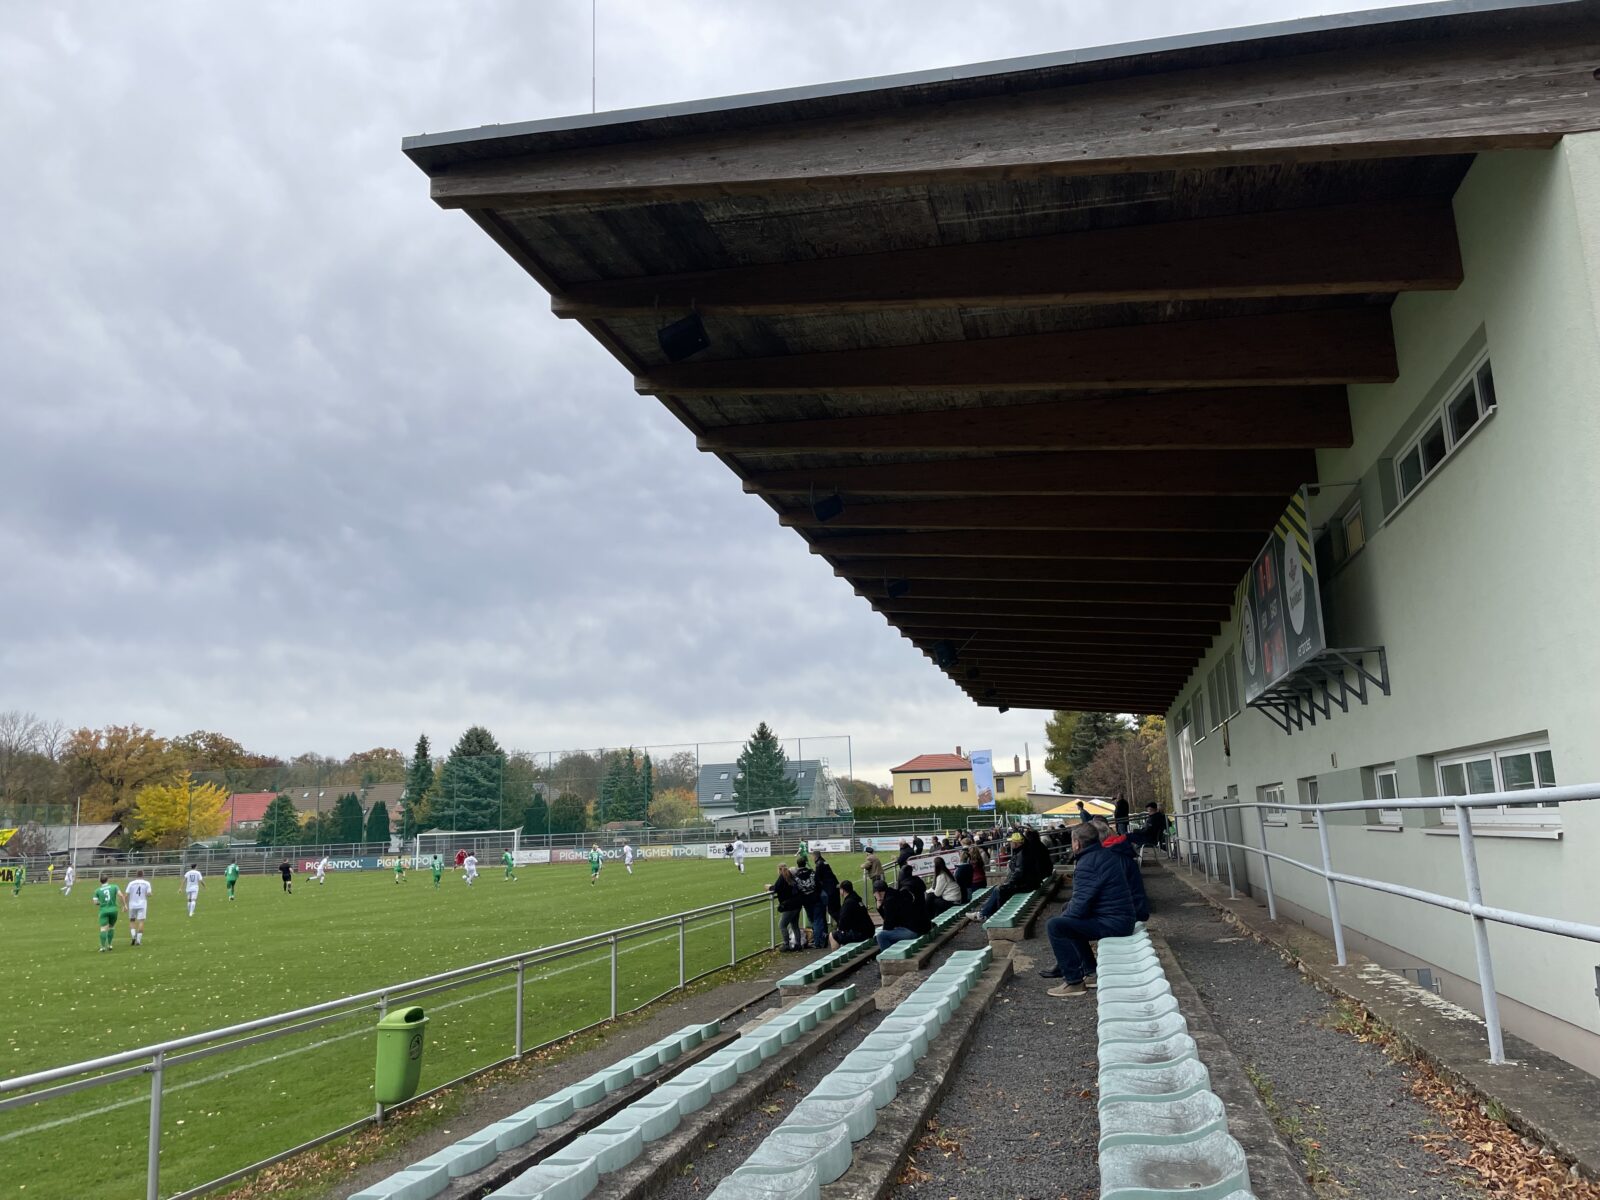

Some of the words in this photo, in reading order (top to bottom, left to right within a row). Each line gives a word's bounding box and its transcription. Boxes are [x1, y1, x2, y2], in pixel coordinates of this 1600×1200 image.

[559, 849, 619, 861] PIGMEPOL
[636, 847, 697, 858] PIGMENTPOL
[305, 859, 362, 871] PIGENTPOL
[103, 889, 111, 902] 3
[135, 885, 141, 896] 4
